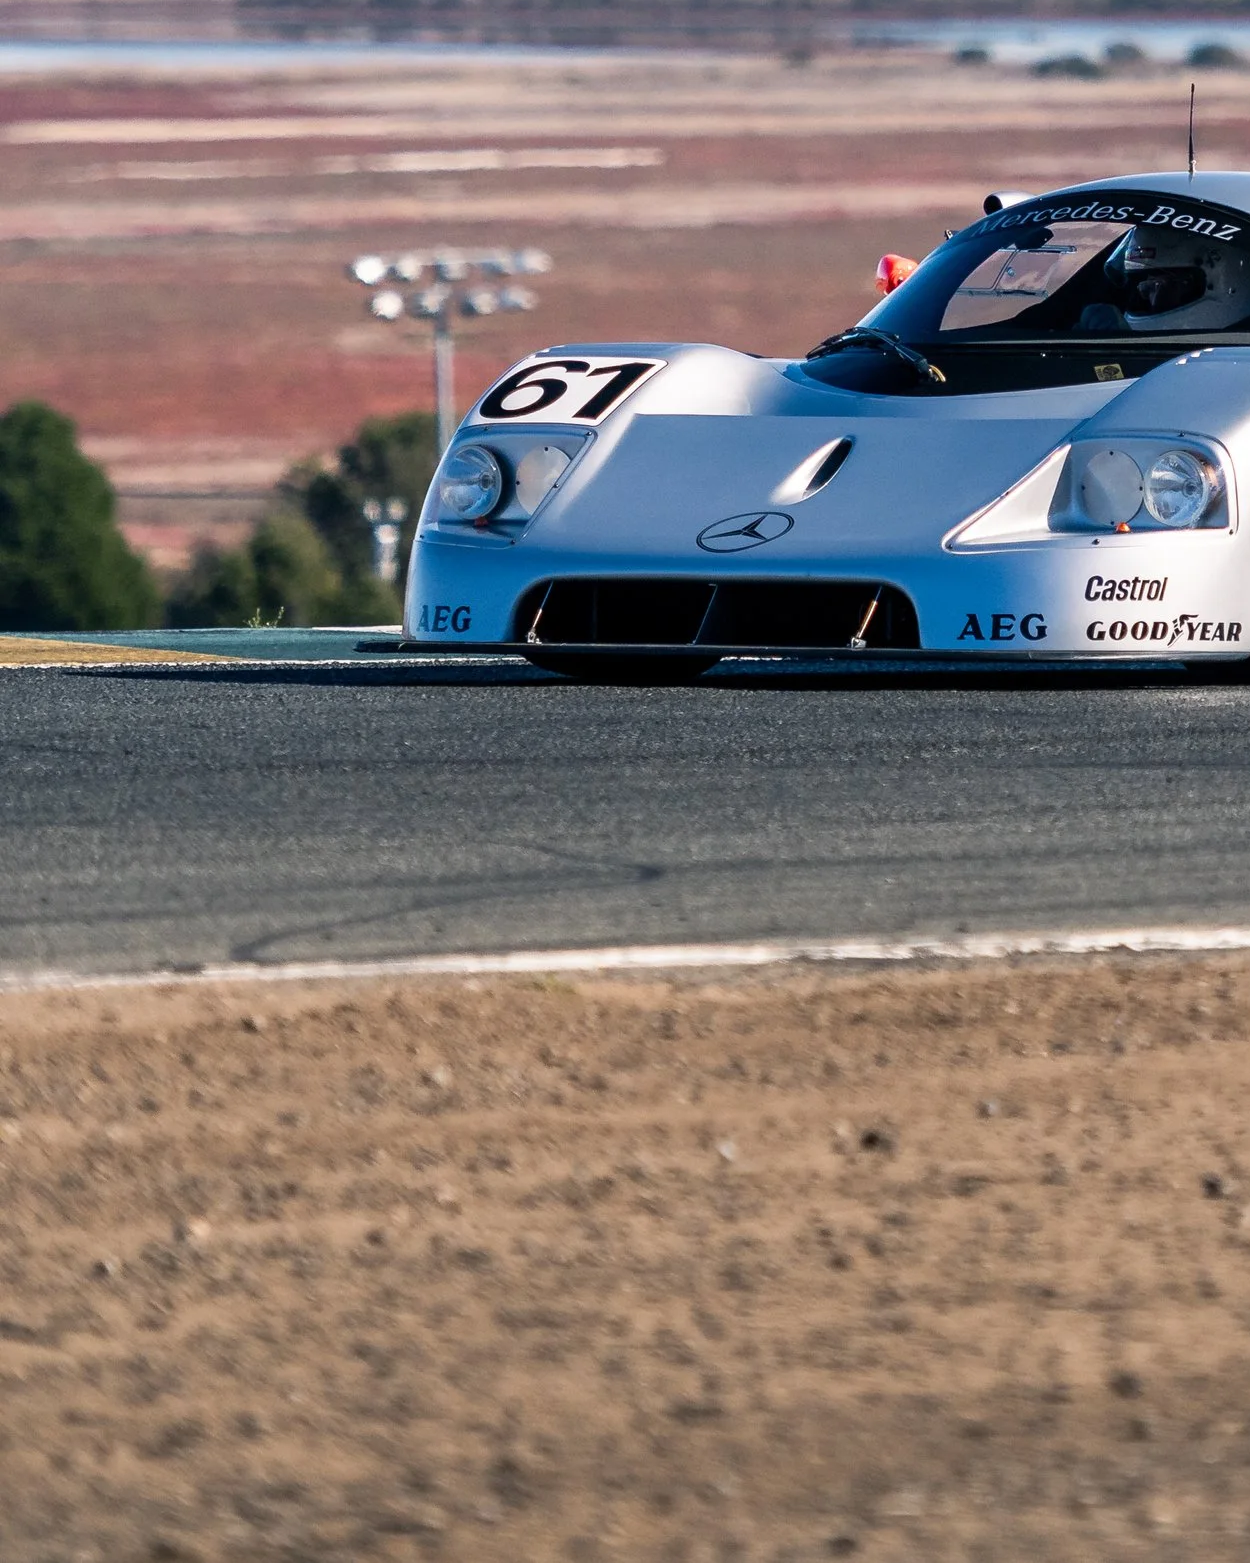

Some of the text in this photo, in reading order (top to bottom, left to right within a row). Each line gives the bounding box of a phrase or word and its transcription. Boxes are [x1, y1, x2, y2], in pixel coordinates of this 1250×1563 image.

[971, 202, 1241, 241] Mercedes-Benz
[479, 360, 656, 420] 61
[1084, 575, 1168, 602] Castrol
[415, 604, 473, 633] AEG
[956, 613, 1048, 641] AEG
[1086, 618, 1242, 643] GOODYEAR
